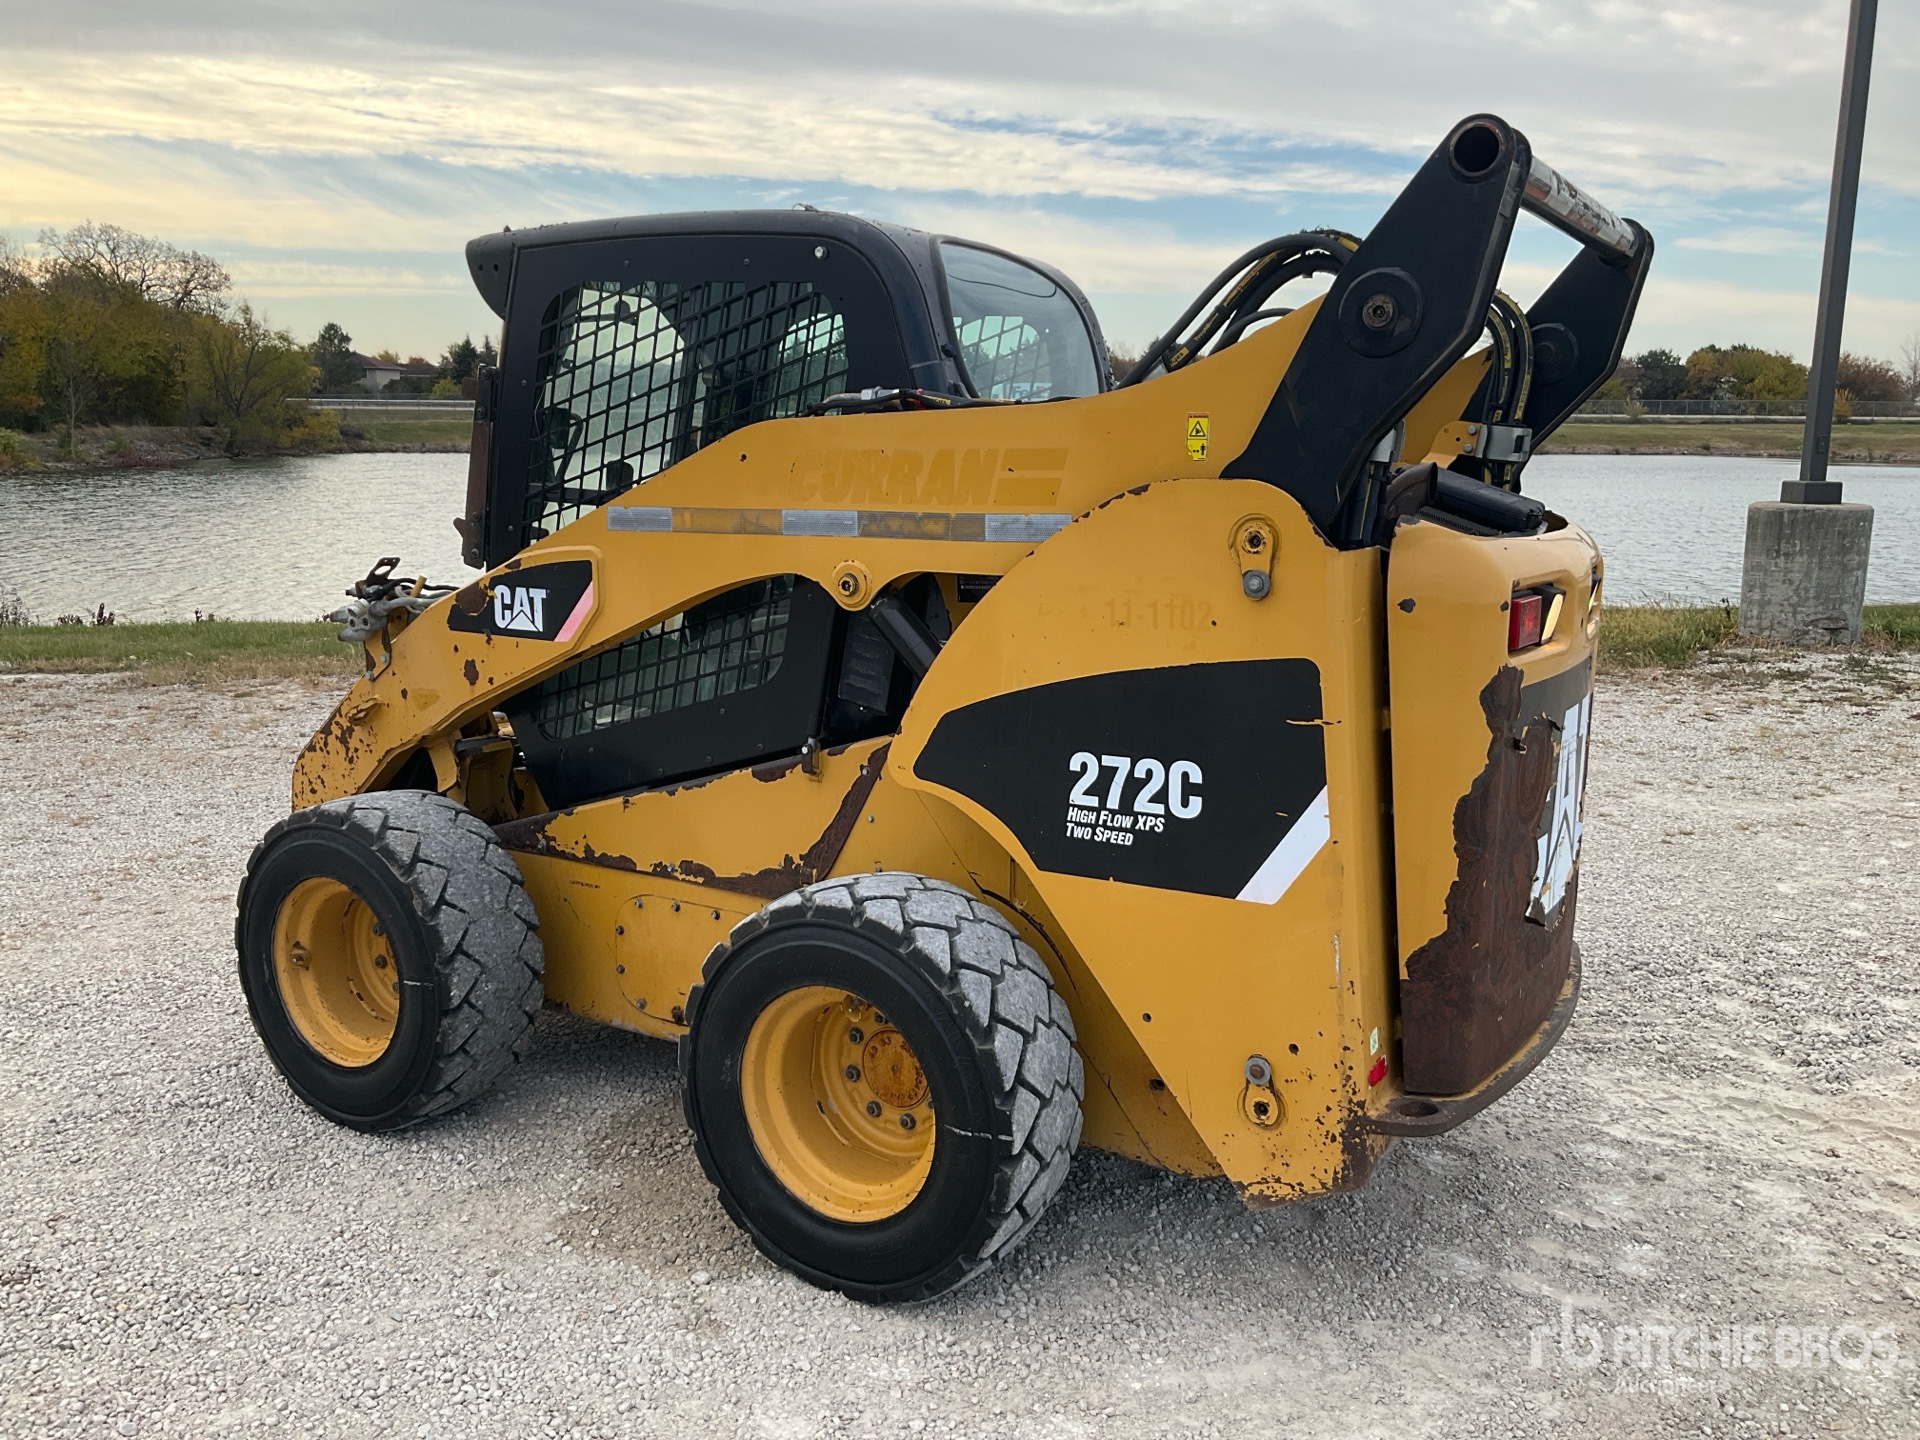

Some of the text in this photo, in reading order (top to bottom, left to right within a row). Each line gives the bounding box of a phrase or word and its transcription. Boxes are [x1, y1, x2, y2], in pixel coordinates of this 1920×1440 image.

[788, 447, 1001, 505] CURRAN
[494, 584, 547, 632] CAT
[1069, 751, 1203, 820] 272C
[1065, 822, 1134, 847] TWO SPEED
[1066, 806, 1166, 834] HIGH FLOW XPS
